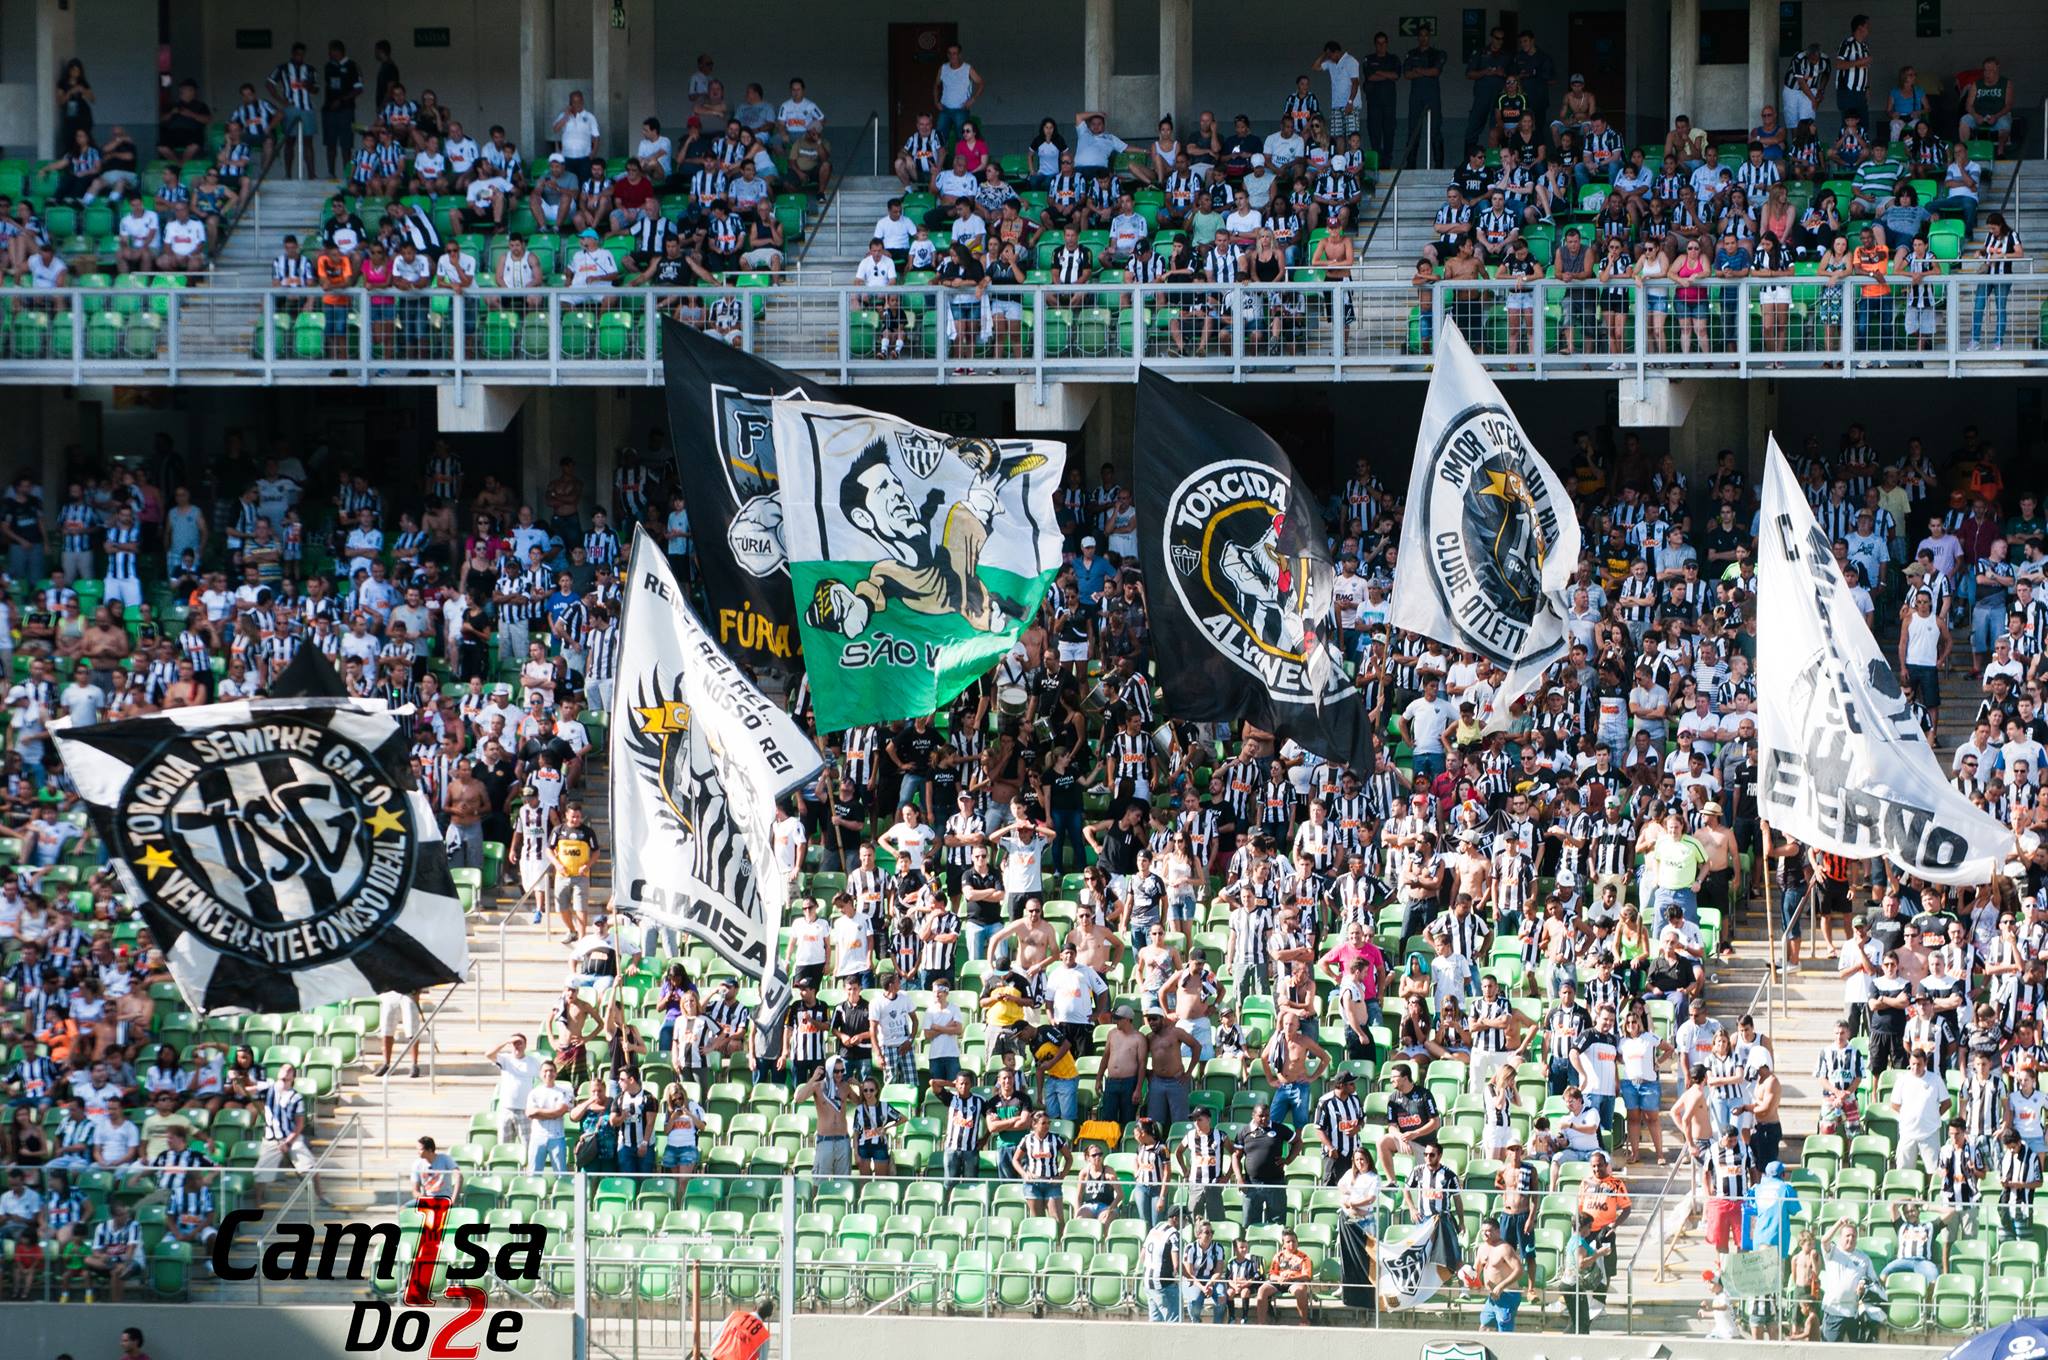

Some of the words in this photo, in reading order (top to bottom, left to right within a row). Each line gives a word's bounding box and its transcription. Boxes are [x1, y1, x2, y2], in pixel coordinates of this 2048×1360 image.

[1466, 180, 1481, 190] FIAT
[901, 436, 940, 451] CAM
[1440, 428, 1487, 490] AMOR
[1176, 471, 1288, 531] TORCIDA
[1174, 546, 1199, 559] CAM
[1642, 539, 1661, 548] BMG
[1335, 593, 1353, 602] BMG
[1436, 531, 1472, 598] CLUBE
[1457, 594, 1529, 655] ATLÉTI
[719, 600, 792, 659] FÚRIA
[839, 631, 917, 669] SÃO
[701, 673, 763, 731] NOSSO
[759, 736, 794, 776] REI
[1123, 753, 1145, 763] BMG
[126, 753, 202, 847] TORCIDA
[192, 725, 323, 764] SEMPRE
[1231, 781, 1252, 792] BMG
[1321, 784, 1340, 793] BMG
[1267, 799, 1283, 807] BMG
[1764, 748, 1970, 870] EERNO
[171, 779, 362, 893] TSG
[365, 835, 407, 897] IDEAL
[630, 878, 767, 969] CAMISA
[1398, 1113, 1421, 1127] BMG
[1586, 1203, 1608, 1212] BMG
[740, 1313, 763, 1336] 118
